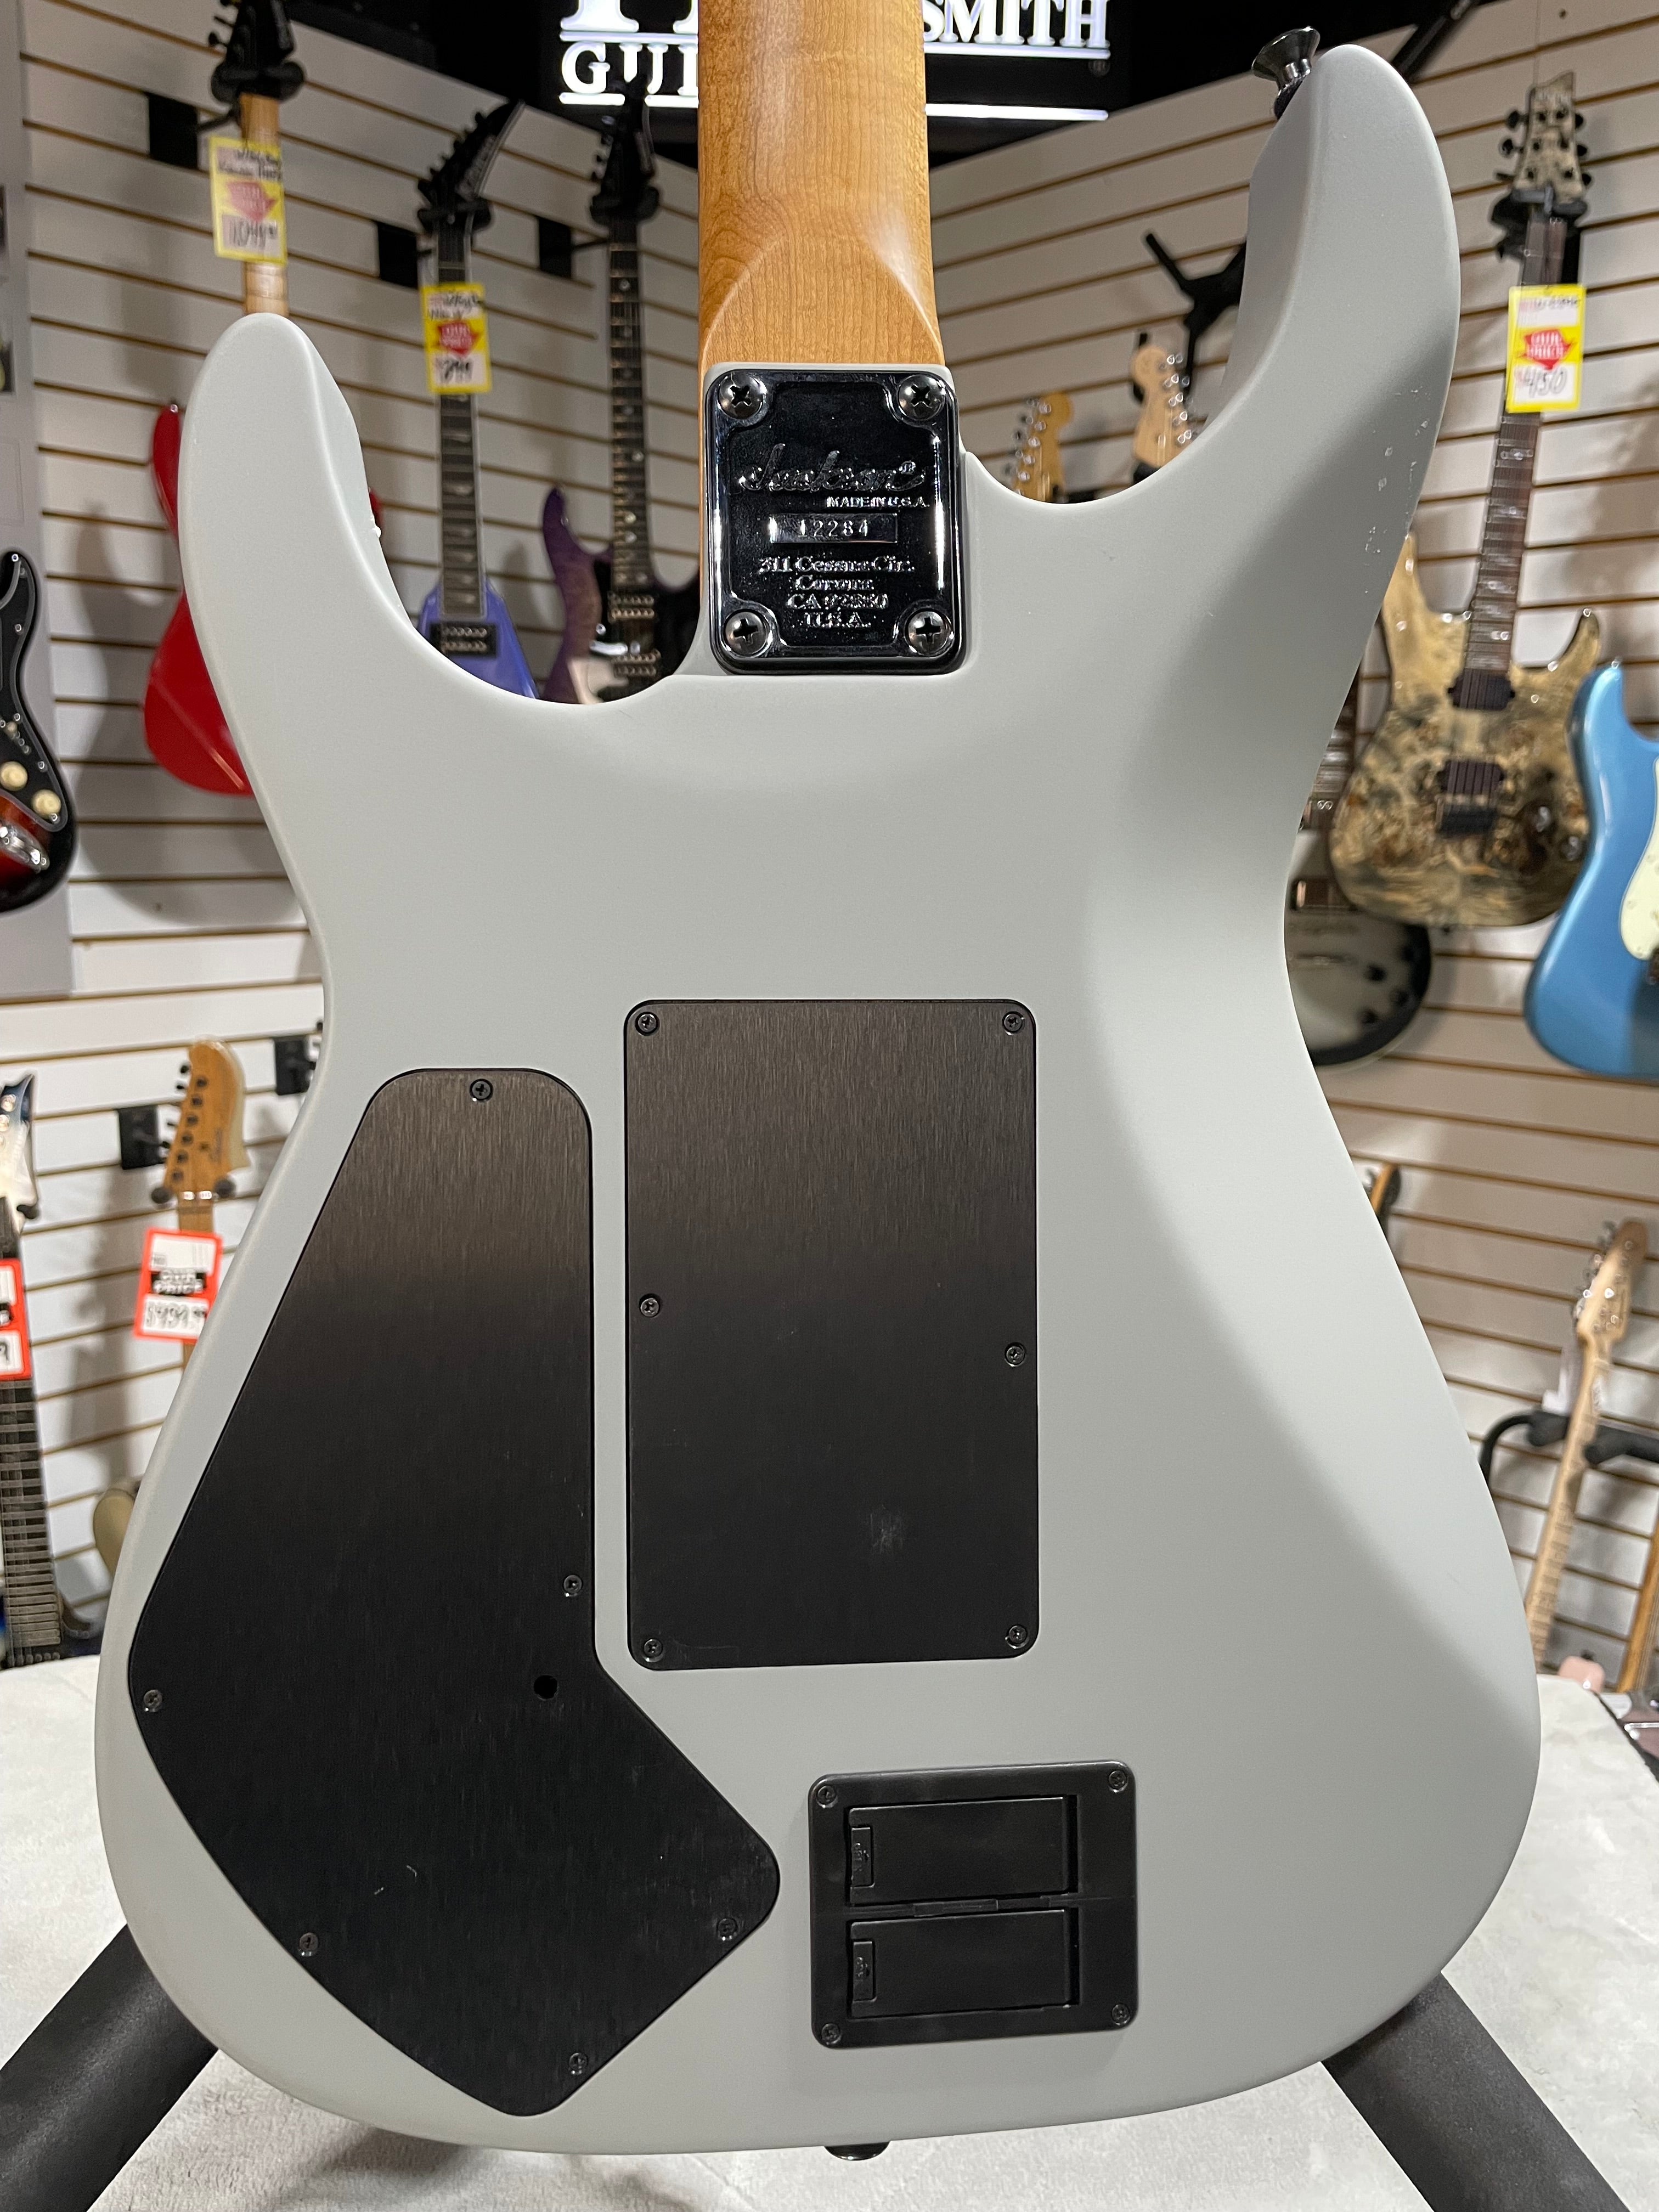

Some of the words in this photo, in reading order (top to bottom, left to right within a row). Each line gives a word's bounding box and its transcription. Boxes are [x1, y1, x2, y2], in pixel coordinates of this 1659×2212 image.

[826, 496, 869, 508] MADE
[870, 496, 886, 508] IN
[798, 519, 868, 538] 12284
[786, 592, 822, 610] CA
